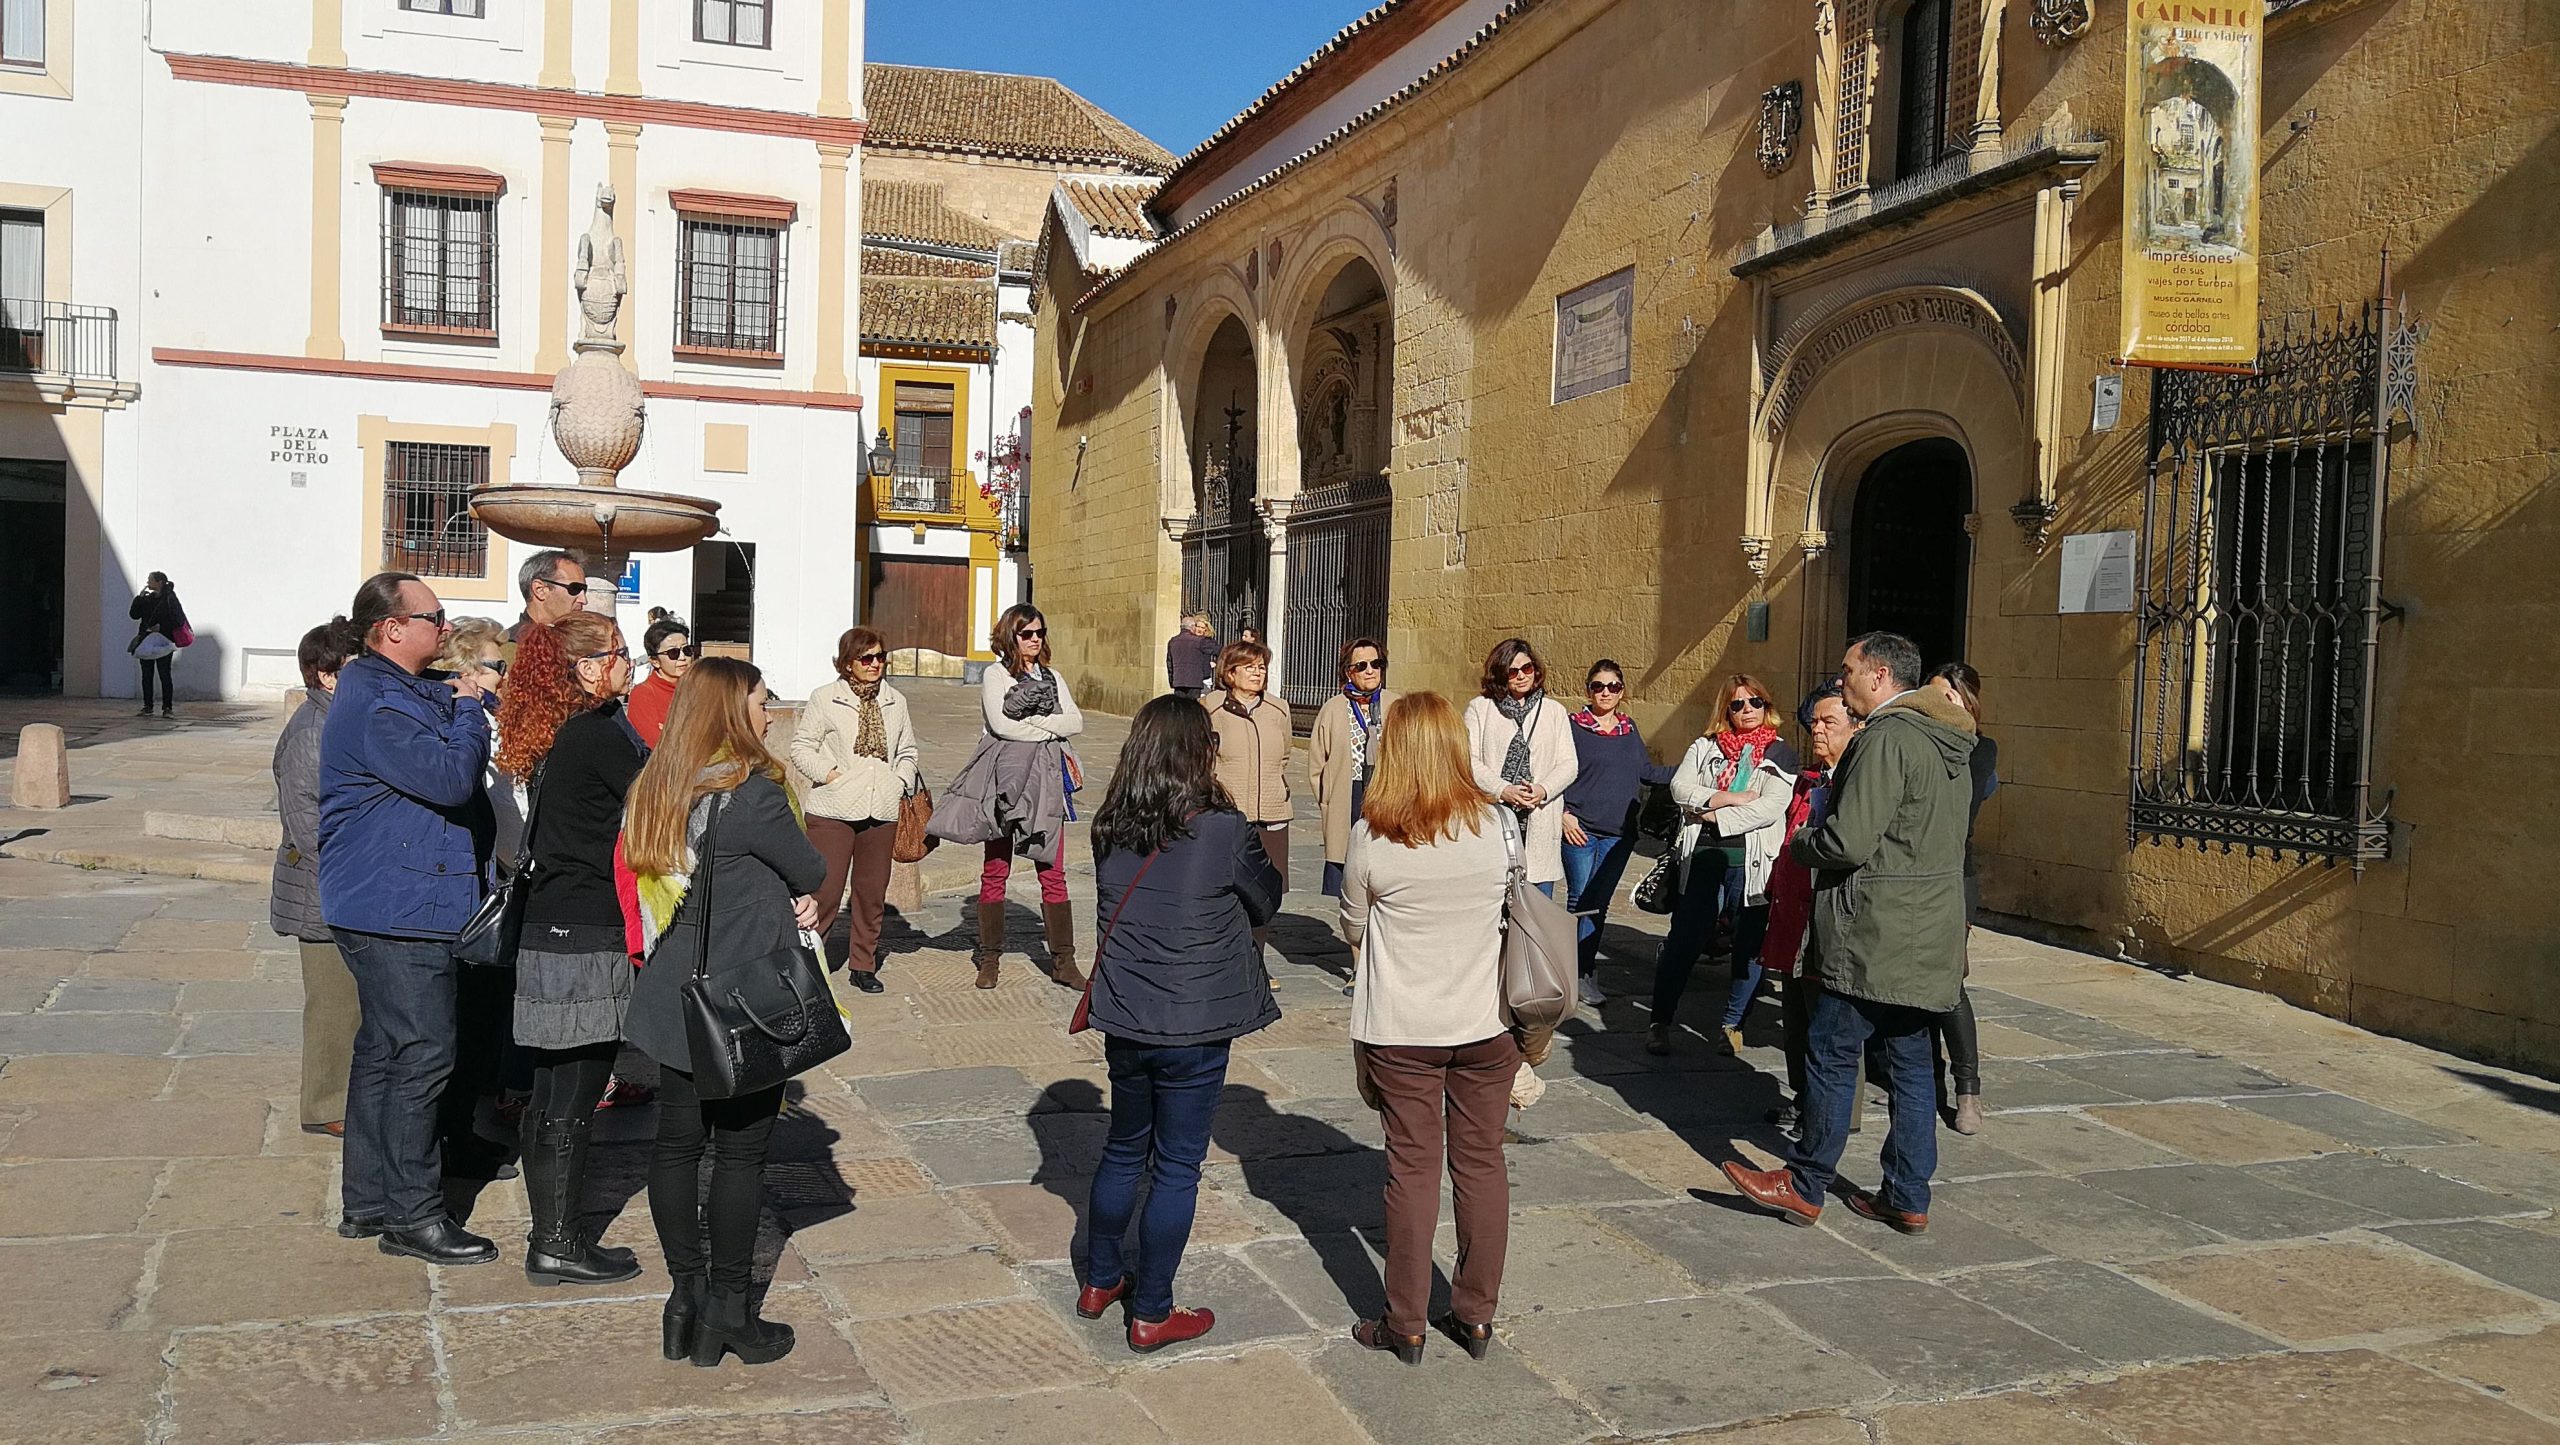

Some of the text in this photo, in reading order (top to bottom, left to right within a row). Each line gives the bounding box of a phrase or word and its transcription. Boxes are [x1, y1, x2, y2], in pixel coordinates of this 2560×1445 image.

[2136, 1, 2255, 28] GARNELO
[2172, 264, 2205, 275] de sus
[2148, 277, 2233, 290] viajes por Europa
[2153, 295, 2223, 304] MUSEO GARNELO
[1896, 299, 1920, 325] de
[2148, 308, 2231, 320] museo de bellas artes
[2165, 319, 2211, 333] córdoba
[270, 425, 329, 440] PLAZA
[283, 439, 317, 451] DEL
[270, 451, 329, 464] POTRO
